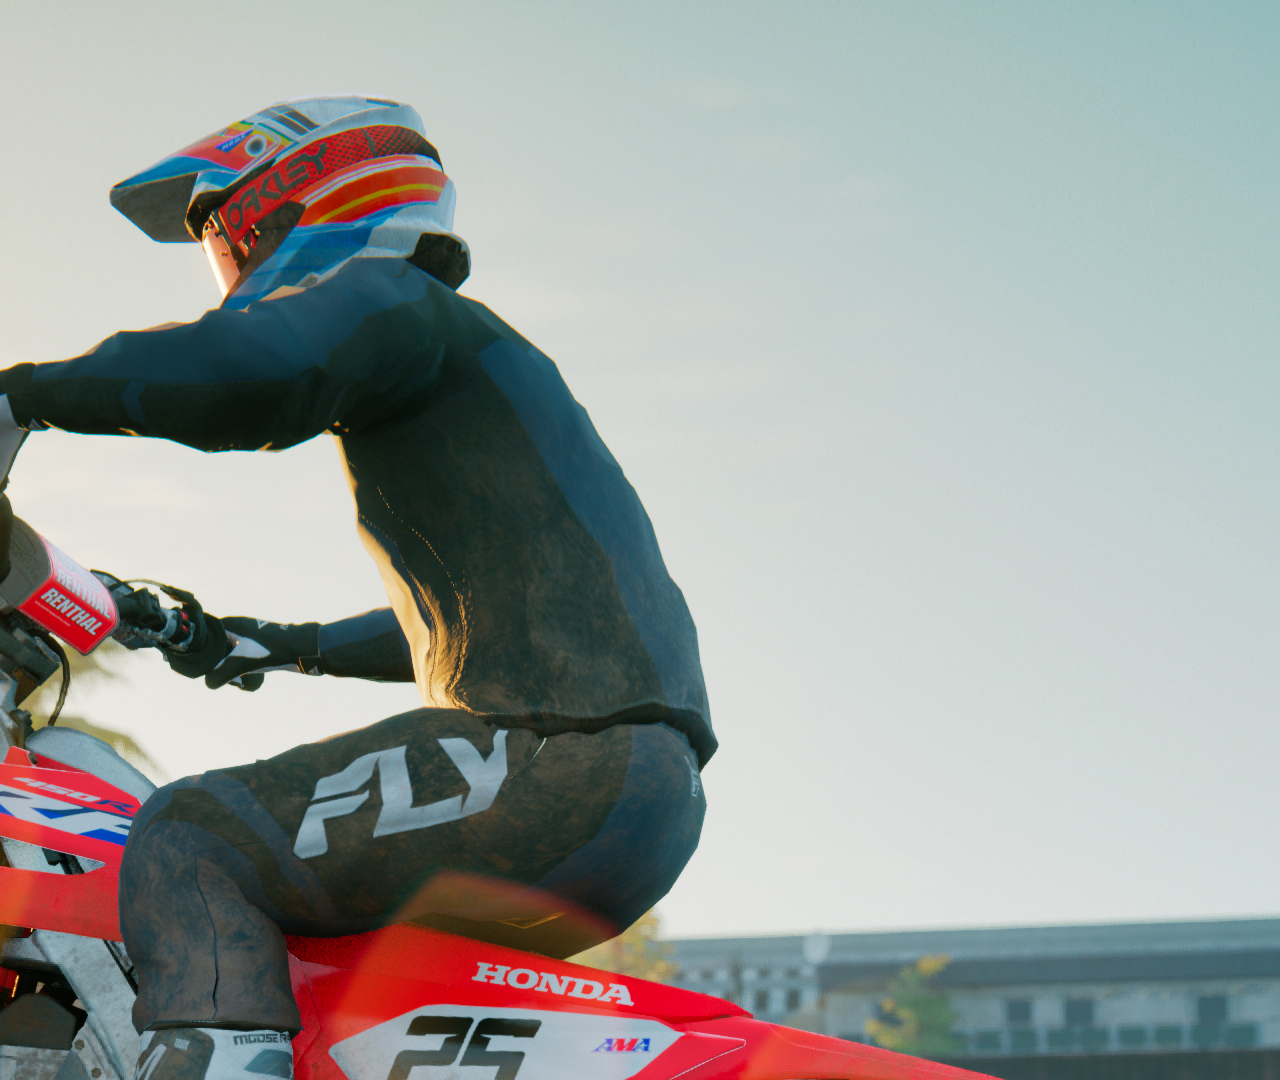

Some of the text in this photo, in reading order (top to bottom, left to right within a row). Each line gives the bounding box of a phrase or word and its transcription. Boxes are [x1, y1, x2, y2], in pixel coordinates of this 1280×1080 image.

[227, 141, 327, 231] OAKLEY
[40, 587, 103, 636] RENTHAL
[56, 568, 111, 619] RENTHAL
[293, 730, 509, 859] FLY
[472, 962, 635, 1006] HONDA
[590, 1037, 651, 1052] AMA
